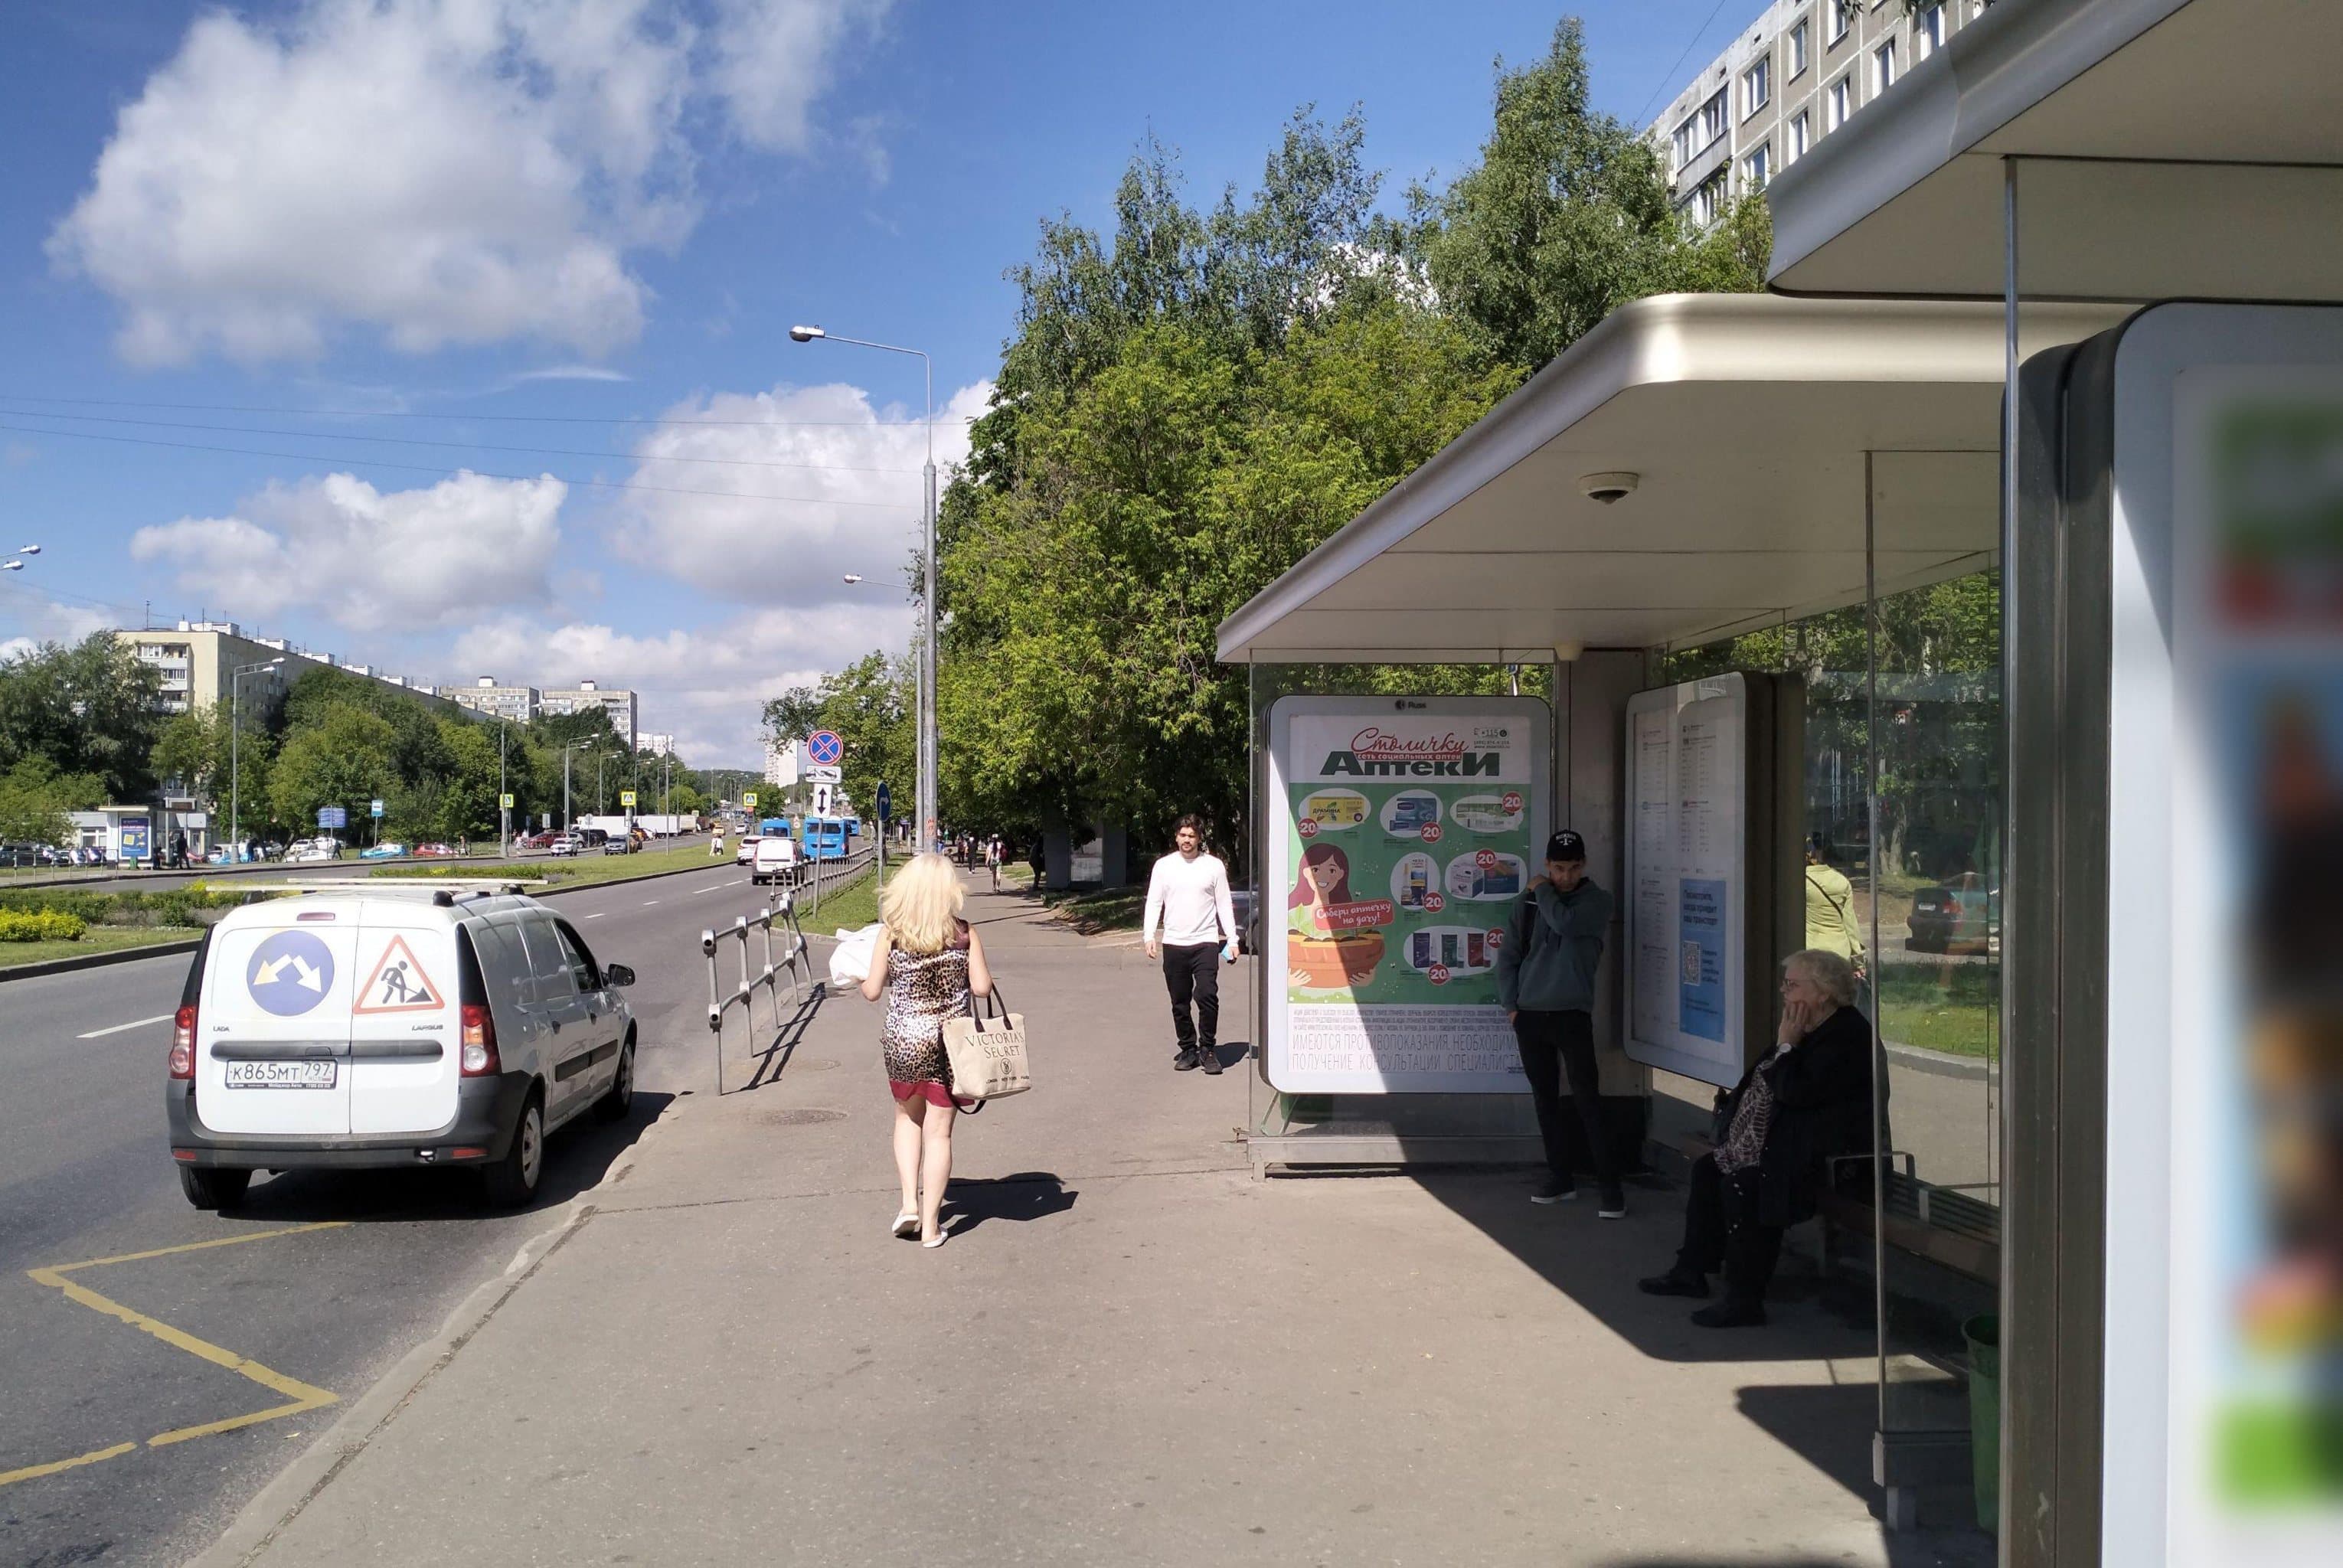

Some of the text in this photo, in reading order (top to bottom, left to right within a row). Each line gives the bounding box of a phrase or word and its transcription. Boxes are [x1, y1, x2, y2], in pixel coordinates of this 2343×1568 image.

[1351, 727, 1469, 752] Столички
[1316, 903, 1391, 919] Собери аптечку
[1356, 912, 1380, 926] дачу!
[1292, 1034, 1341, 1050] ИМЕЮТСЯ
[984, 1045, 1021, 1059] SECRET
[1292, 1054, 1354, 1070] ПОЛУЧЕНИЕ
[1360, 1054, 1440, 1070] КОНСУЛЬТАЦИИ
[233, 1063, 331, 1080] К865МТ 797
